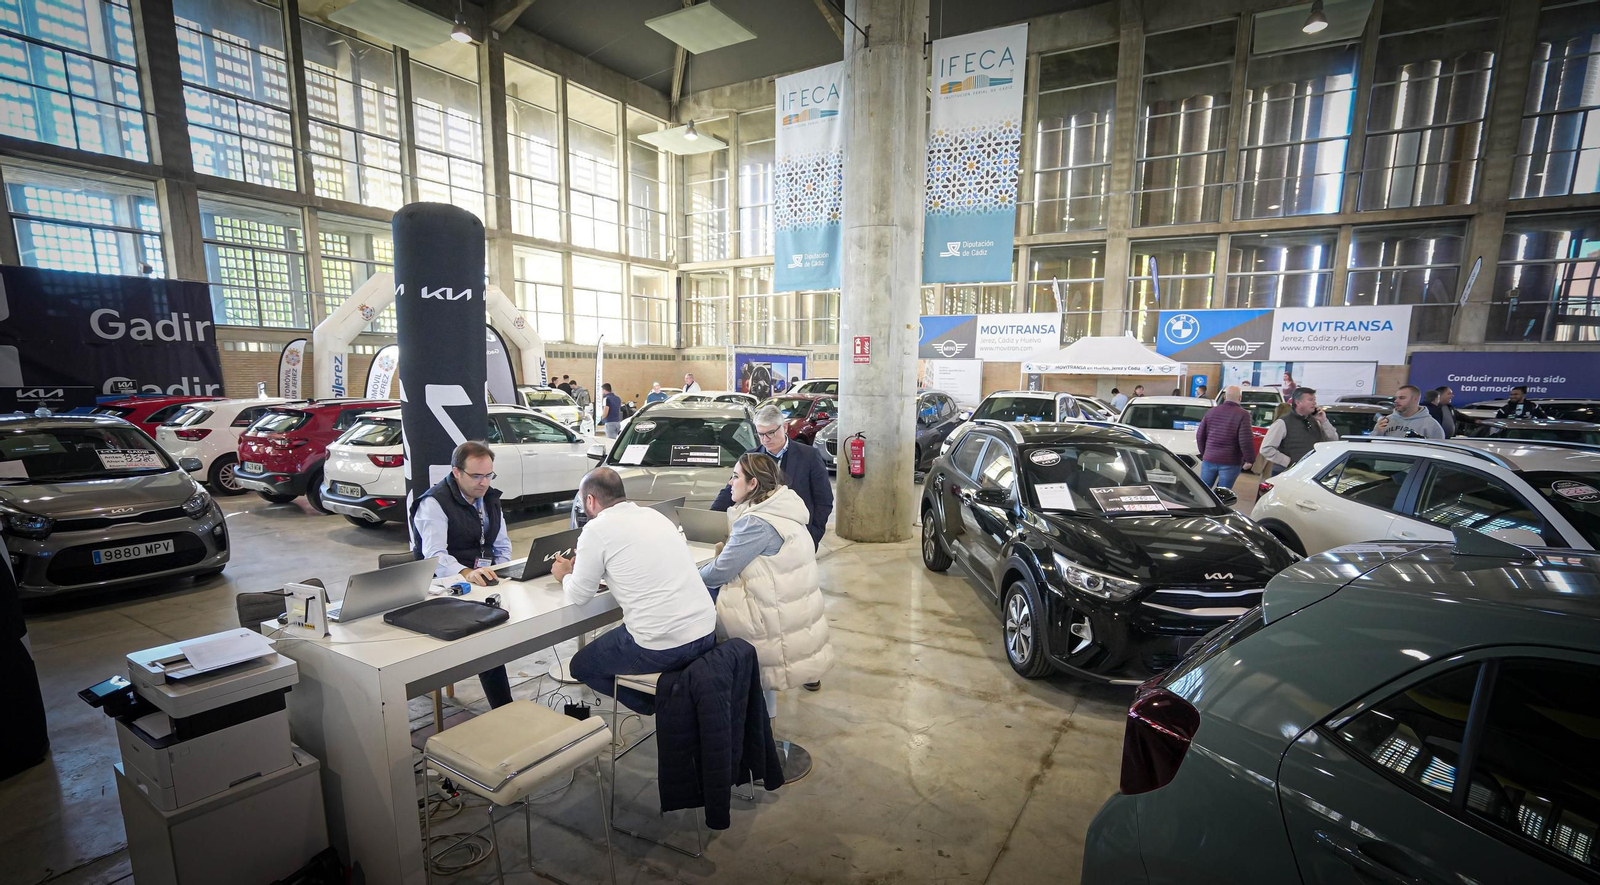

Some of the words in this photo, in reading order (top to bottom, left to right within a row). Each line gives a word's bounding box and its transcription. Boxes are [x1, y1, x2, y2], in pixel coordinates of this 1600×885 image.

[940, 46, 1015, 78] IFECA
[781, 82, 840, 111] IFECA
[962, 240, 994, 249] Diputación
[962, 249, 970, 257] de
[421, 286, 472, 301] KIA
[89, 308, 211, 342] Gadir
[980, 324, 1056, 335] MOVITRANSA
[1281, 320, 1394, 332] MOVITRANSA
[1021, 336, 1042, 344] Huelva
[1281, 335, 1305, 343] Jerez,
[1280, 344, 1359, 352] www.movitran.com
[1447, 374, 1492, 382] Conducir
[1493, 375, 1525, 383] nunca
[1527, 375, 1541, 383] ha
[1543, 375, 1567, 384] sido
[379, 374, 390, 399] JEREZ
[16, 388, 65, 398] KIA
[104, 546, 140, 560] 9880
[145, 541, 170, 555] MPV
[1204, 572, 1234, 580] KIA
